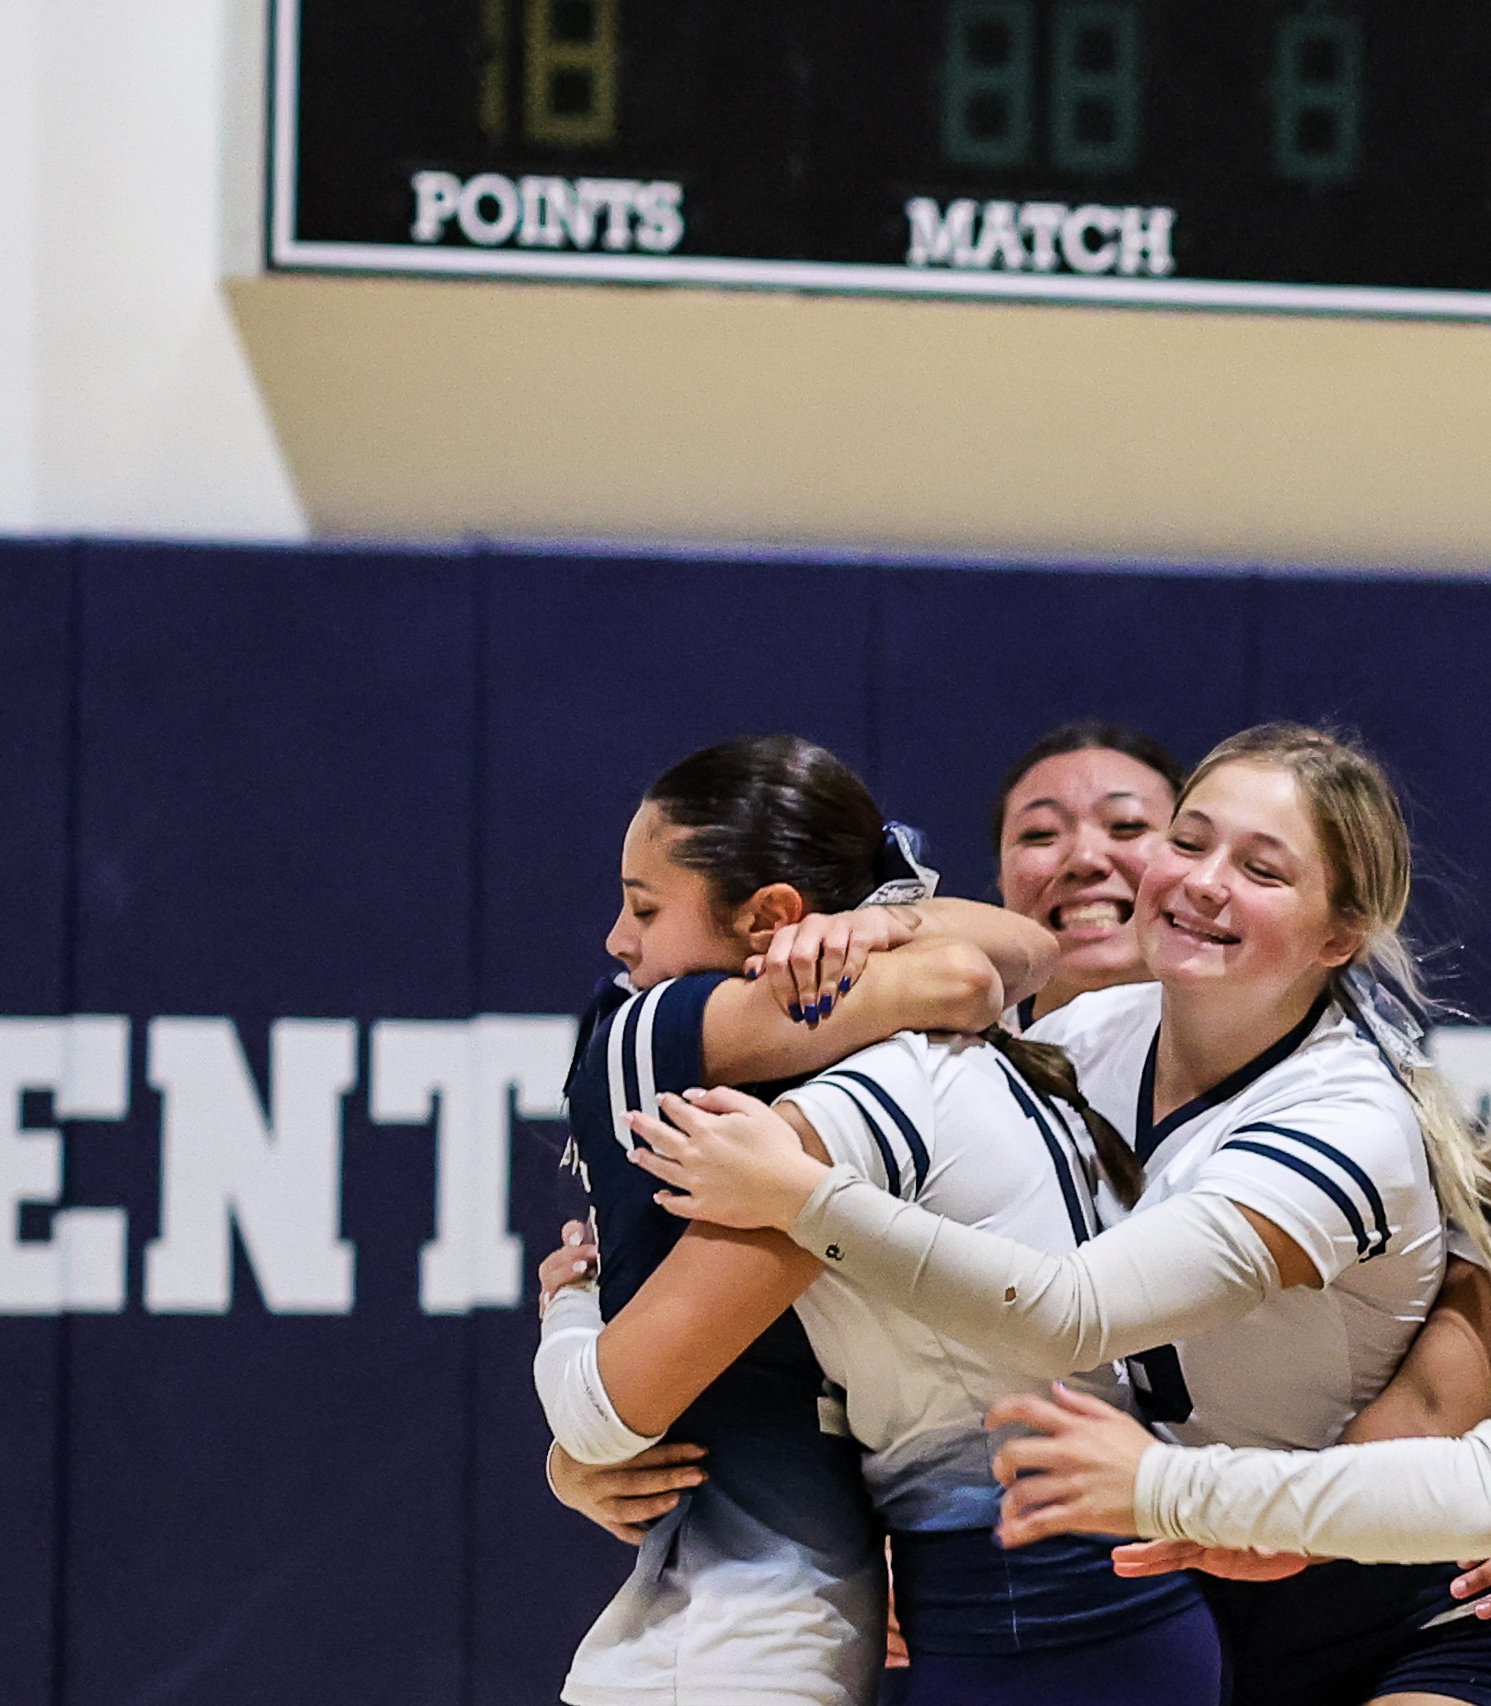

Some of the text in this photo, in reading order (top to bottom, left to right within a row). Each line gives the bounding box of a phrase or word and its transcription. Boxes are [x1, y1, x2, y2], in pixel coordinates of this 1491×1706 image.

[410, 169, 685, 252] POINTS
[906, 197, 1176, 277] MATCH
[0, 1013, 579, 1315] ENT
